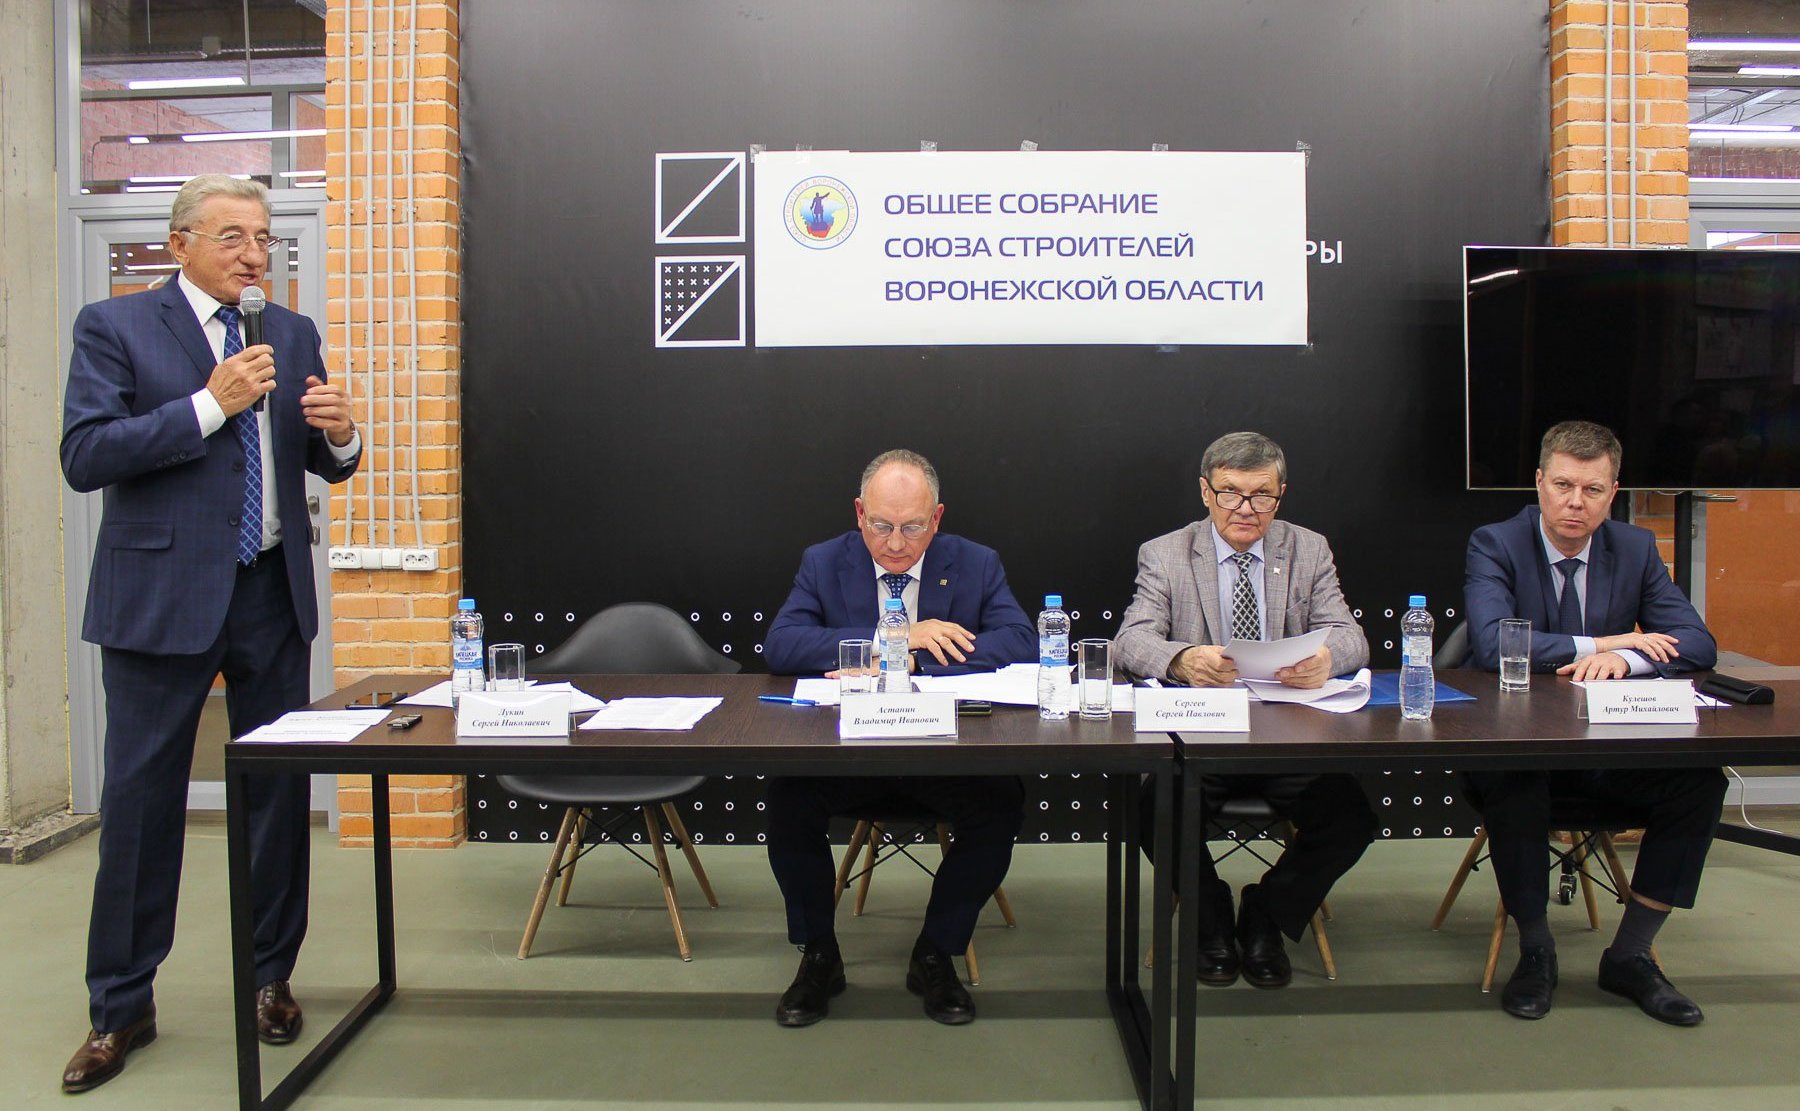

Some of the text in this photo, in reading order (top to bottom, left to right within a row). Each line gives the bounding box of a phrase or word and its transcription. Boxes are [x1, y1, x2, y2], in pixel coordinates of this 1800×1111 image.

[884, 193, 1159, 215] ОБЩЕЕ СОБРАНИЕ
[884, 232, 1194, 258] СОЮЗА СТРОИТЕЛЕЙ
[885, 275, 1264, 302] ВОРОНЕЖСКОЙ ОБЛАСТИ
[1174, 699, 1206, 709] Сергеев
[1622, 695, 1657, 704] Кулешов
[498, 708, 525, 717] Лукин
[877, 706, 916, 714] Астанин
[1155, 709, 1226, 719] Сергей Павлович
[1602, 705, 1680, 714] Артур Михайлович
[472, 719, 551, 729] Сергей Николаевич
[853, 716, 940, 726] Владимир Иванович
